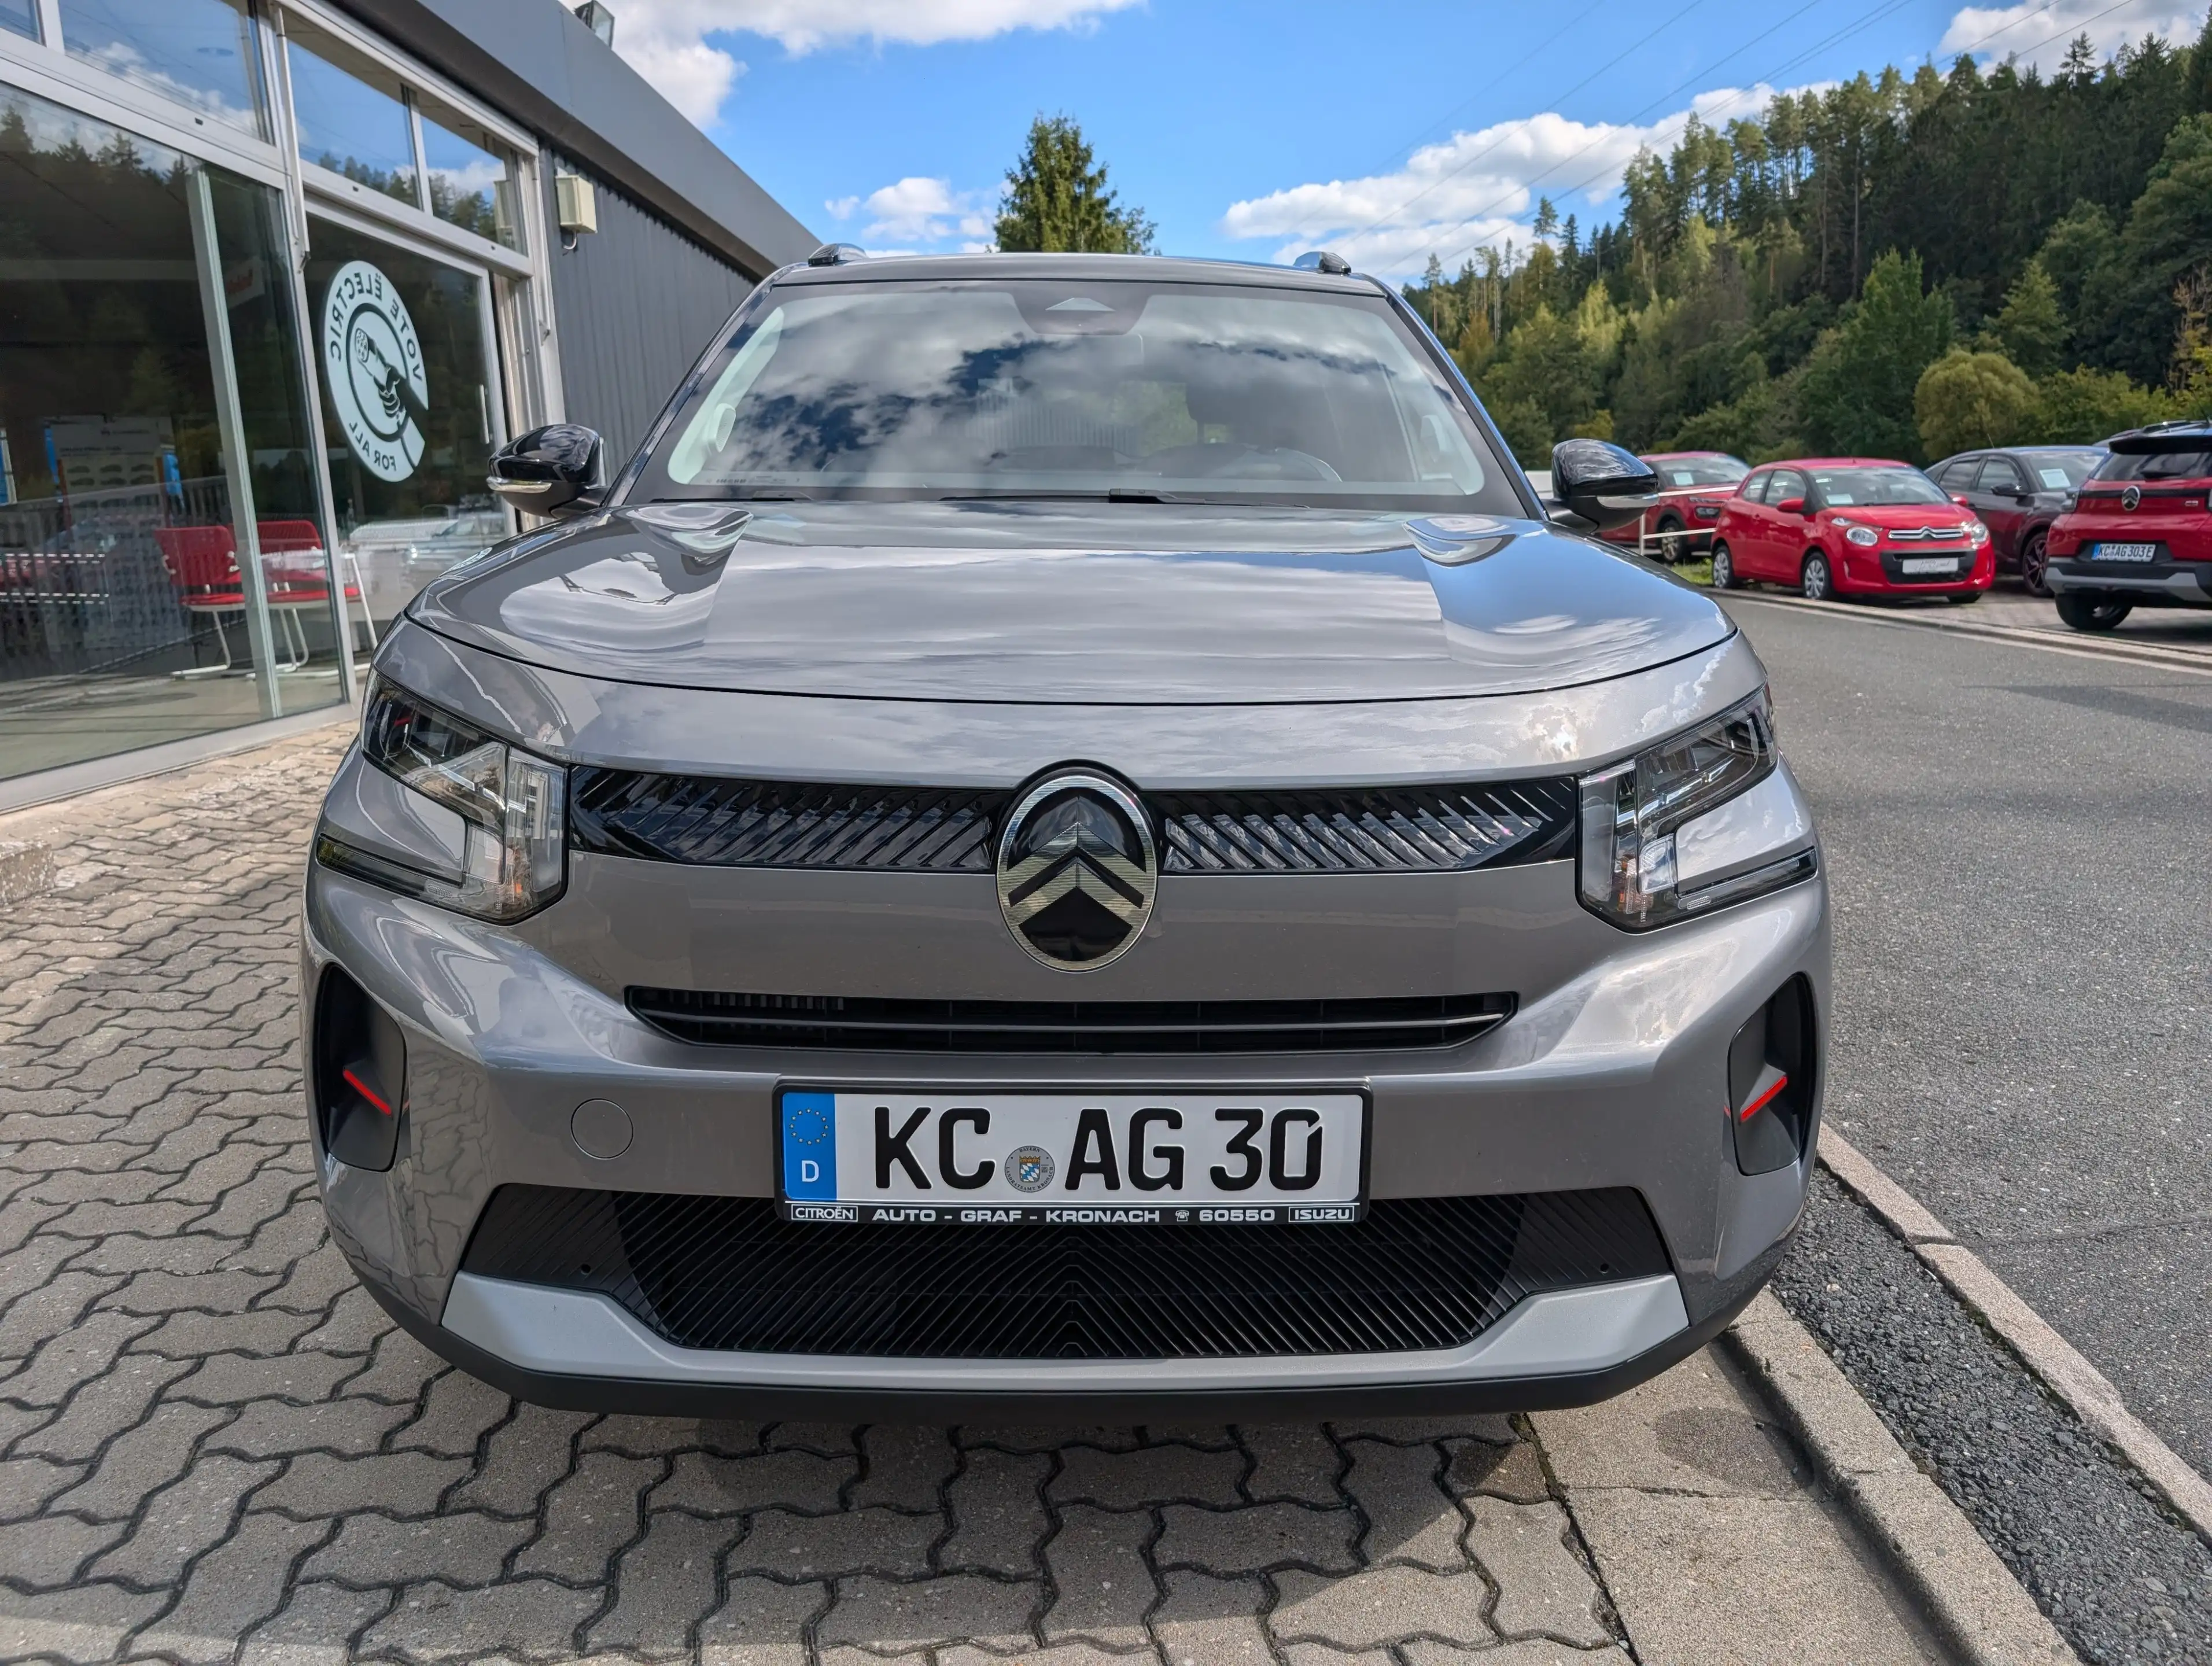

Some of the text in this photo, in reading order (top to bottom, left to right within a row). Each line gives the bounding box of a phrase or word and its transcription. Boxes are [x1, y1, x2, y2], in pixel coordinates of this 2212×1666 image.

[2114, 546, 2128, 557] AG
[875, 1106, 1323, 1191] KC AG 30
[801, 1160, 820, 1182] D
[1005, 1166, 1053, 1191] LANDRATSAMT KRONACH
[795, 1206, 853, 1219] CITROËN
[872, 1209, 936, 1222] AUTO
[960, 1210, 1022, 1222] GRAF
[1046, 1210, 1160, 1222] KRONACH
[1199, 1210, 1275, 1222] 60550
[1295, 1209, 1350, 1220] ISUZU
